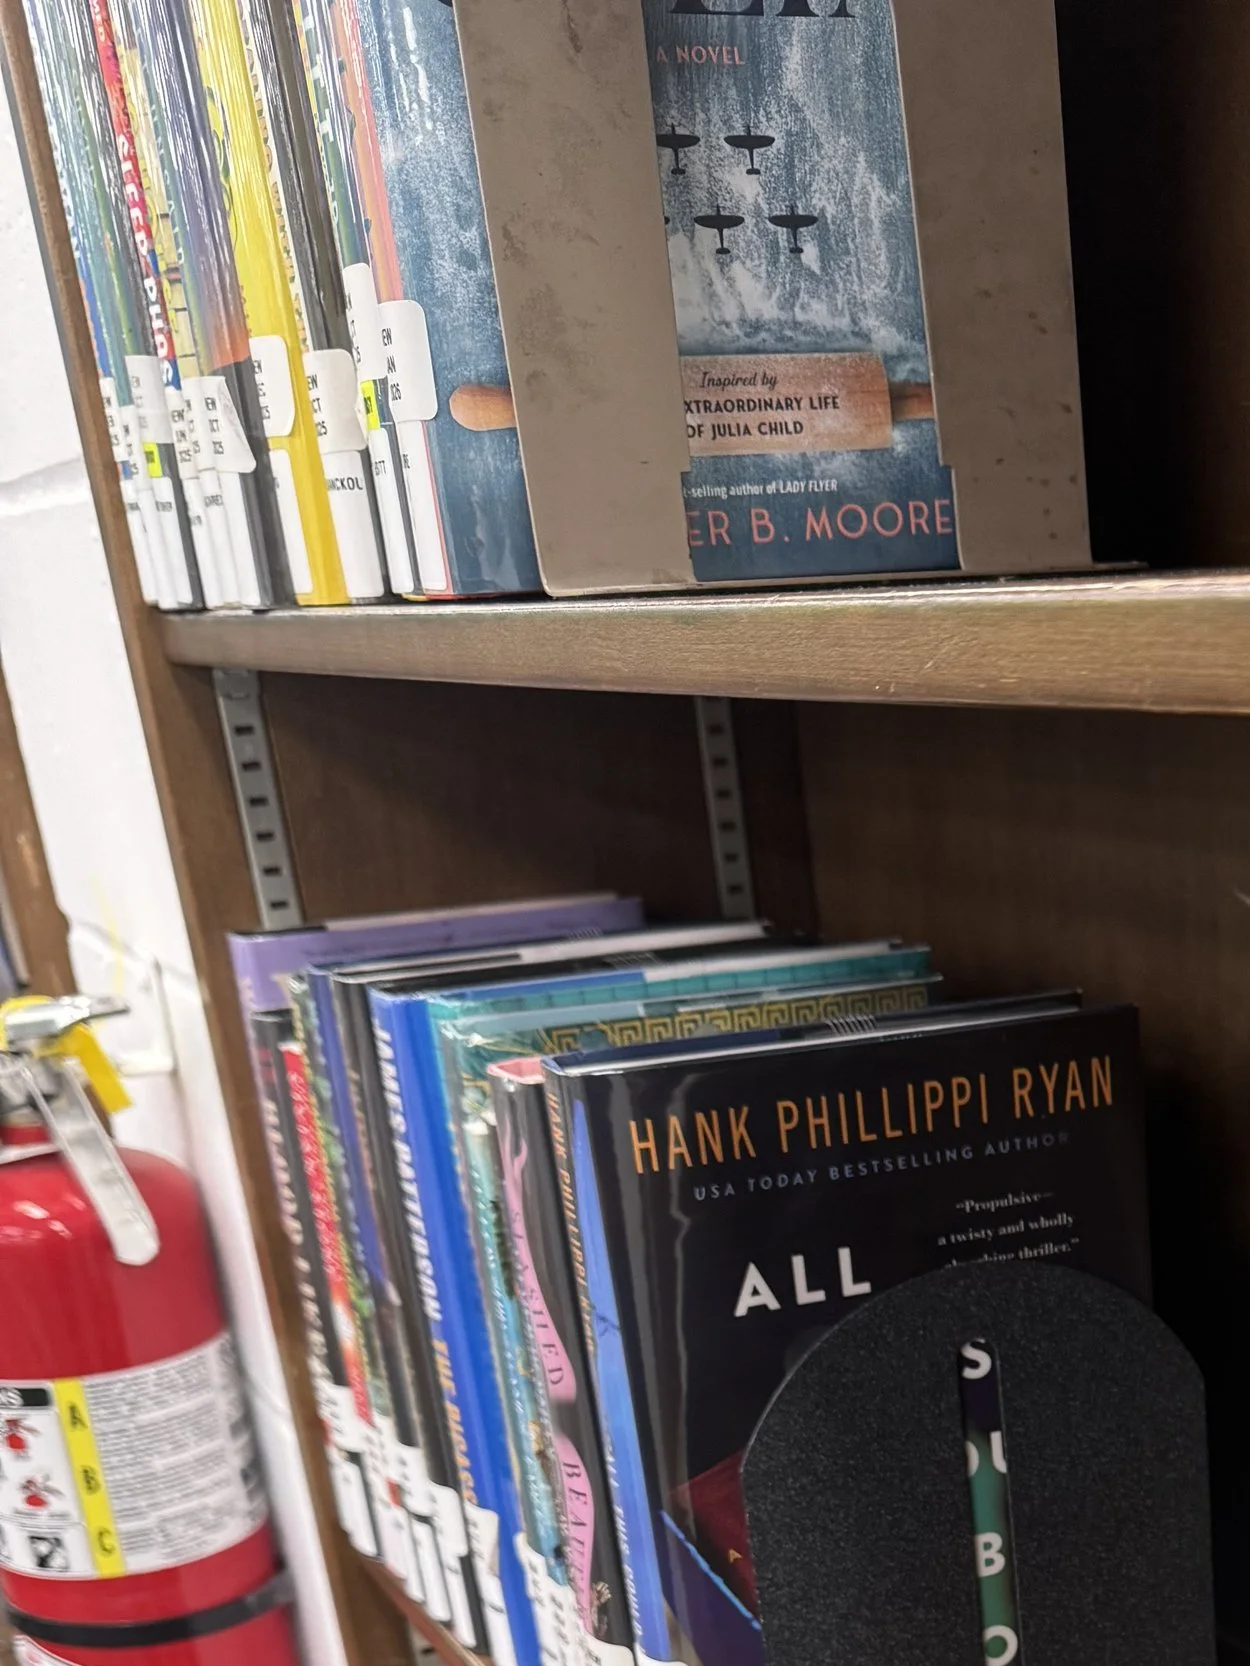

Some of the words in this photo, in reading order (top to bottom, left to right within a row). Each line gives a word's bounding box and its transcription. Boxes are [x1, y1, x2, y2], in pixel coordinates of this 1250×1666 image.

[656, 46, 669, 63] A
[676, 45, 746, 65] NOVEL
[699, 370, 757, 391] Inspired
[760, 371, 778, 391] by
[684, 396, 803, 415] XTRAORDINARY
[809, 395, 841, 411] LIFE
[686, 423, 705, 439] OF
[711, 422, 752, 441] JULIA
[757, 420, 804, 437] CHILD
[729, 480, 764, 497] author
[765, 479, 778, 494] of
[779, 479, 806, 494] LADY
[808, 478, 838, 493] FLYER
[687, 509, 731, 547] ER
[750, 507, 790, 544] B.
[805, 499, 953, 541] MOORE
[628, 1104, 756, 1175] HANK
[776, 1073, 988, 1154] PHILLIPPI
[1012, 1055, 1113, 1119] RYAN
[693, 1183, 736, 1201] USA
[748, 1169, 818, 1193] TODAY
[829, 1145, 974, 1181] BESTSELLING
[984, 1131, 1070, 1157] AUTHOR
[938, 1236, 947, 1246] a
[950, 1227, 993, 1242] twisty
[998, 1219, 1025, 1236] and
[1029, 1212, 1074, 1228] wholly
[733, 1246, 872, 1317] ALL
